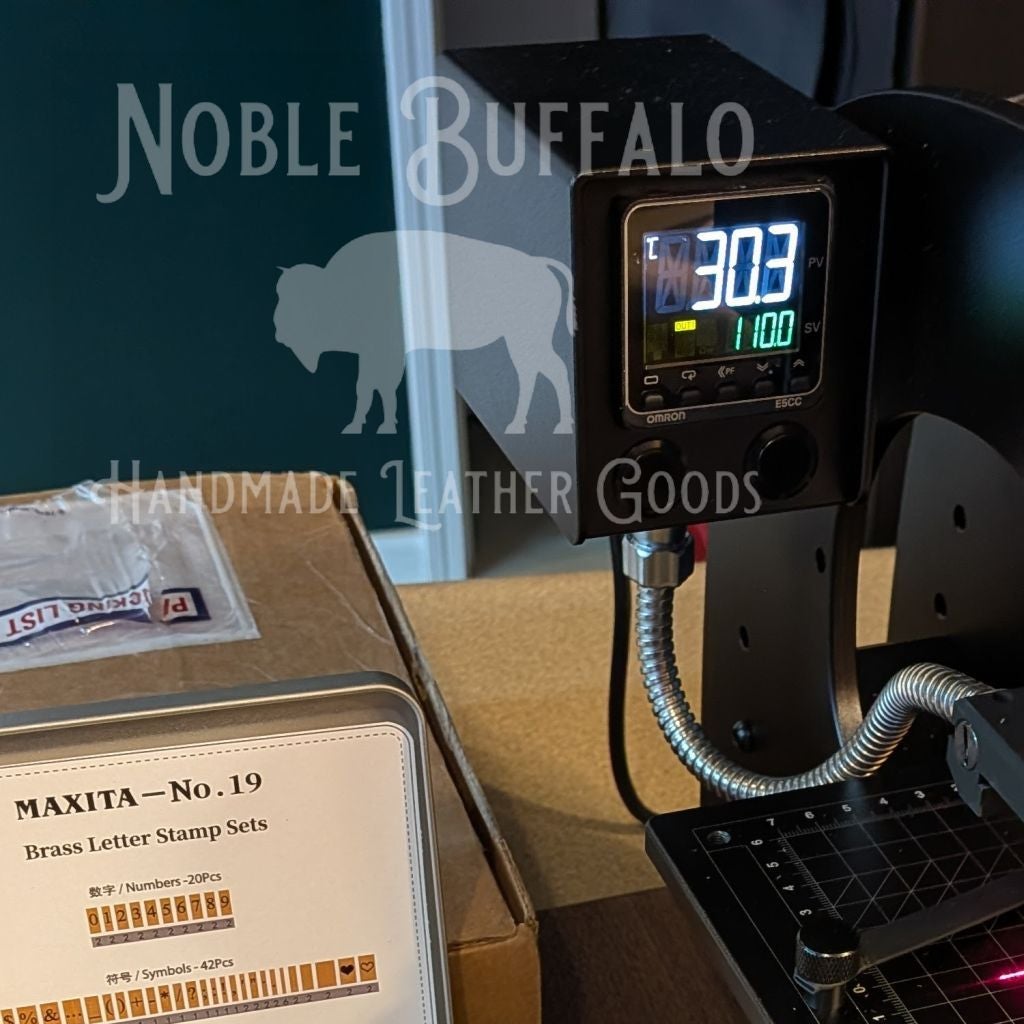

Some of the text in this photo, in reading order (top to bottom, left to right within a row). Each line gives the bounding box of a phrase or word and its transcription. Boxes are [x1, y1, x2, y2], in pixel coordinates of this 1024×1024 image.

[691, 223, 799, 311] 30.3
[808, 256, 824, 268] PV
[735, 310, 795, 350] 110.0
[804, 321, 821, 334] SV
[775, 397, 802, 408] E5CC
[646, 411, 686, 424] OMRON
[6, 603, 59, 637] LIST
[24, 817, 268, 860] Brass Letter Stamp Sets
[88, 884, 116, 898] 数字
[125, 877, 181, 893] Numbers
[106, 972, 133, 985] 符号
[142, 963, 192, 980] Symbols
